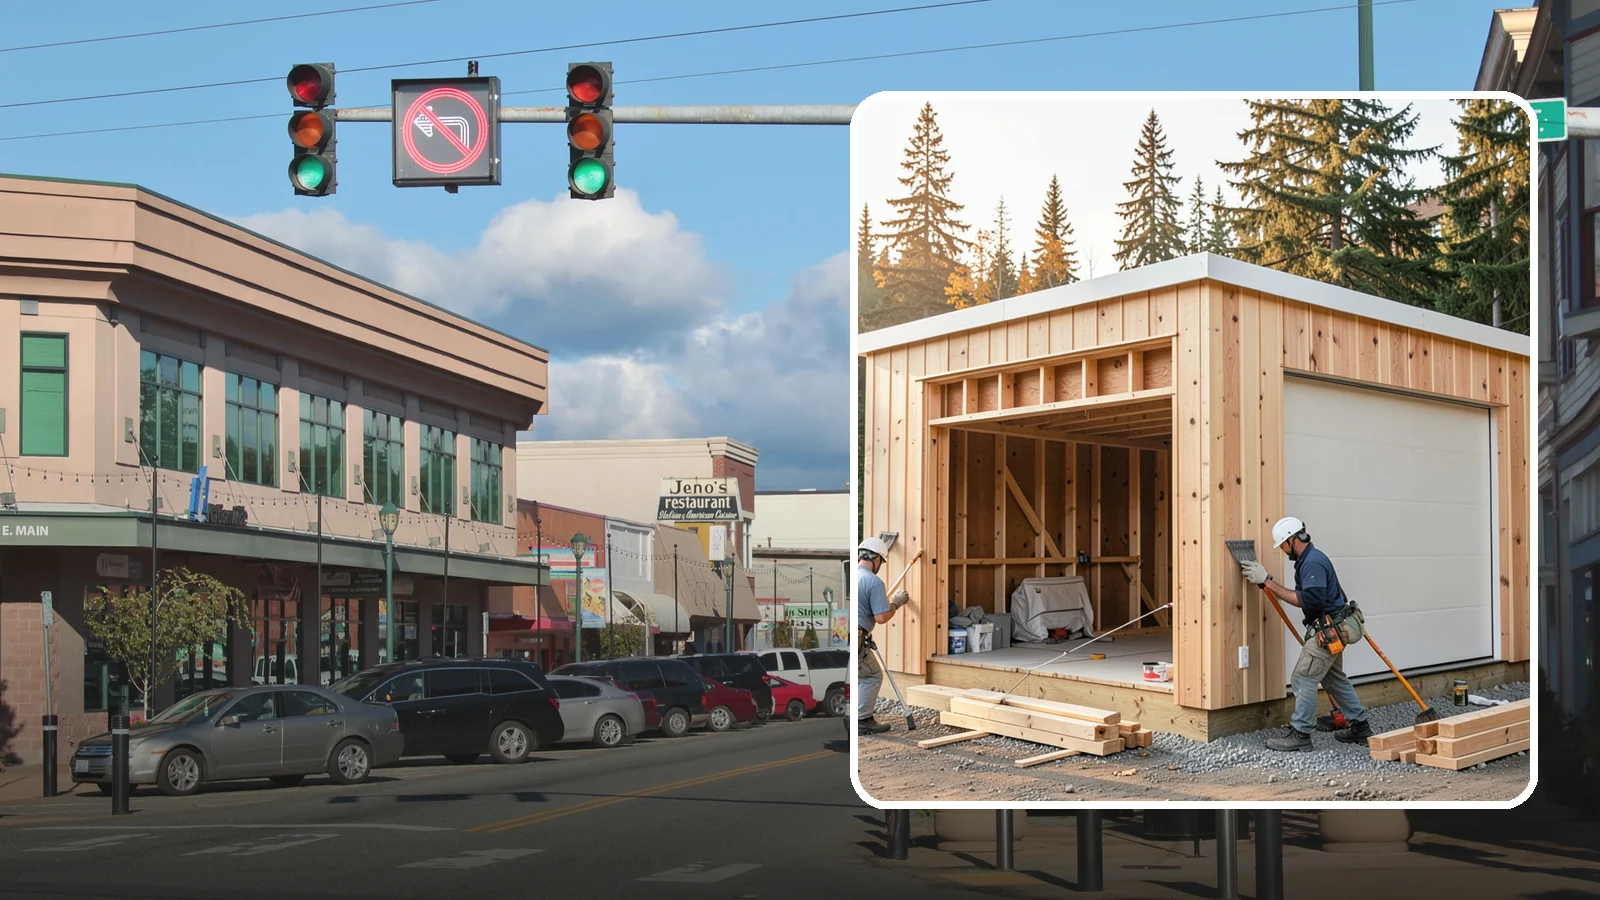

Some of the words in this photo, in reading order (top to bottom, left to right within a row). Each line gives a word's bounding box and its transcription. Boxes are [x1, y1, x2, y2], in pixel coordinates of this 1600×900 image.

[669, 479, 728, 495] Jeno's
[665, 496, 731, 509] restaurant
[685, 509, 714, 519] American
[715, 509, 737, 519] Cuisine
[2, 525, 13, 536] E.
[15, 525, 49, 536] MAIN
[797, 607, 828, 617] Street
